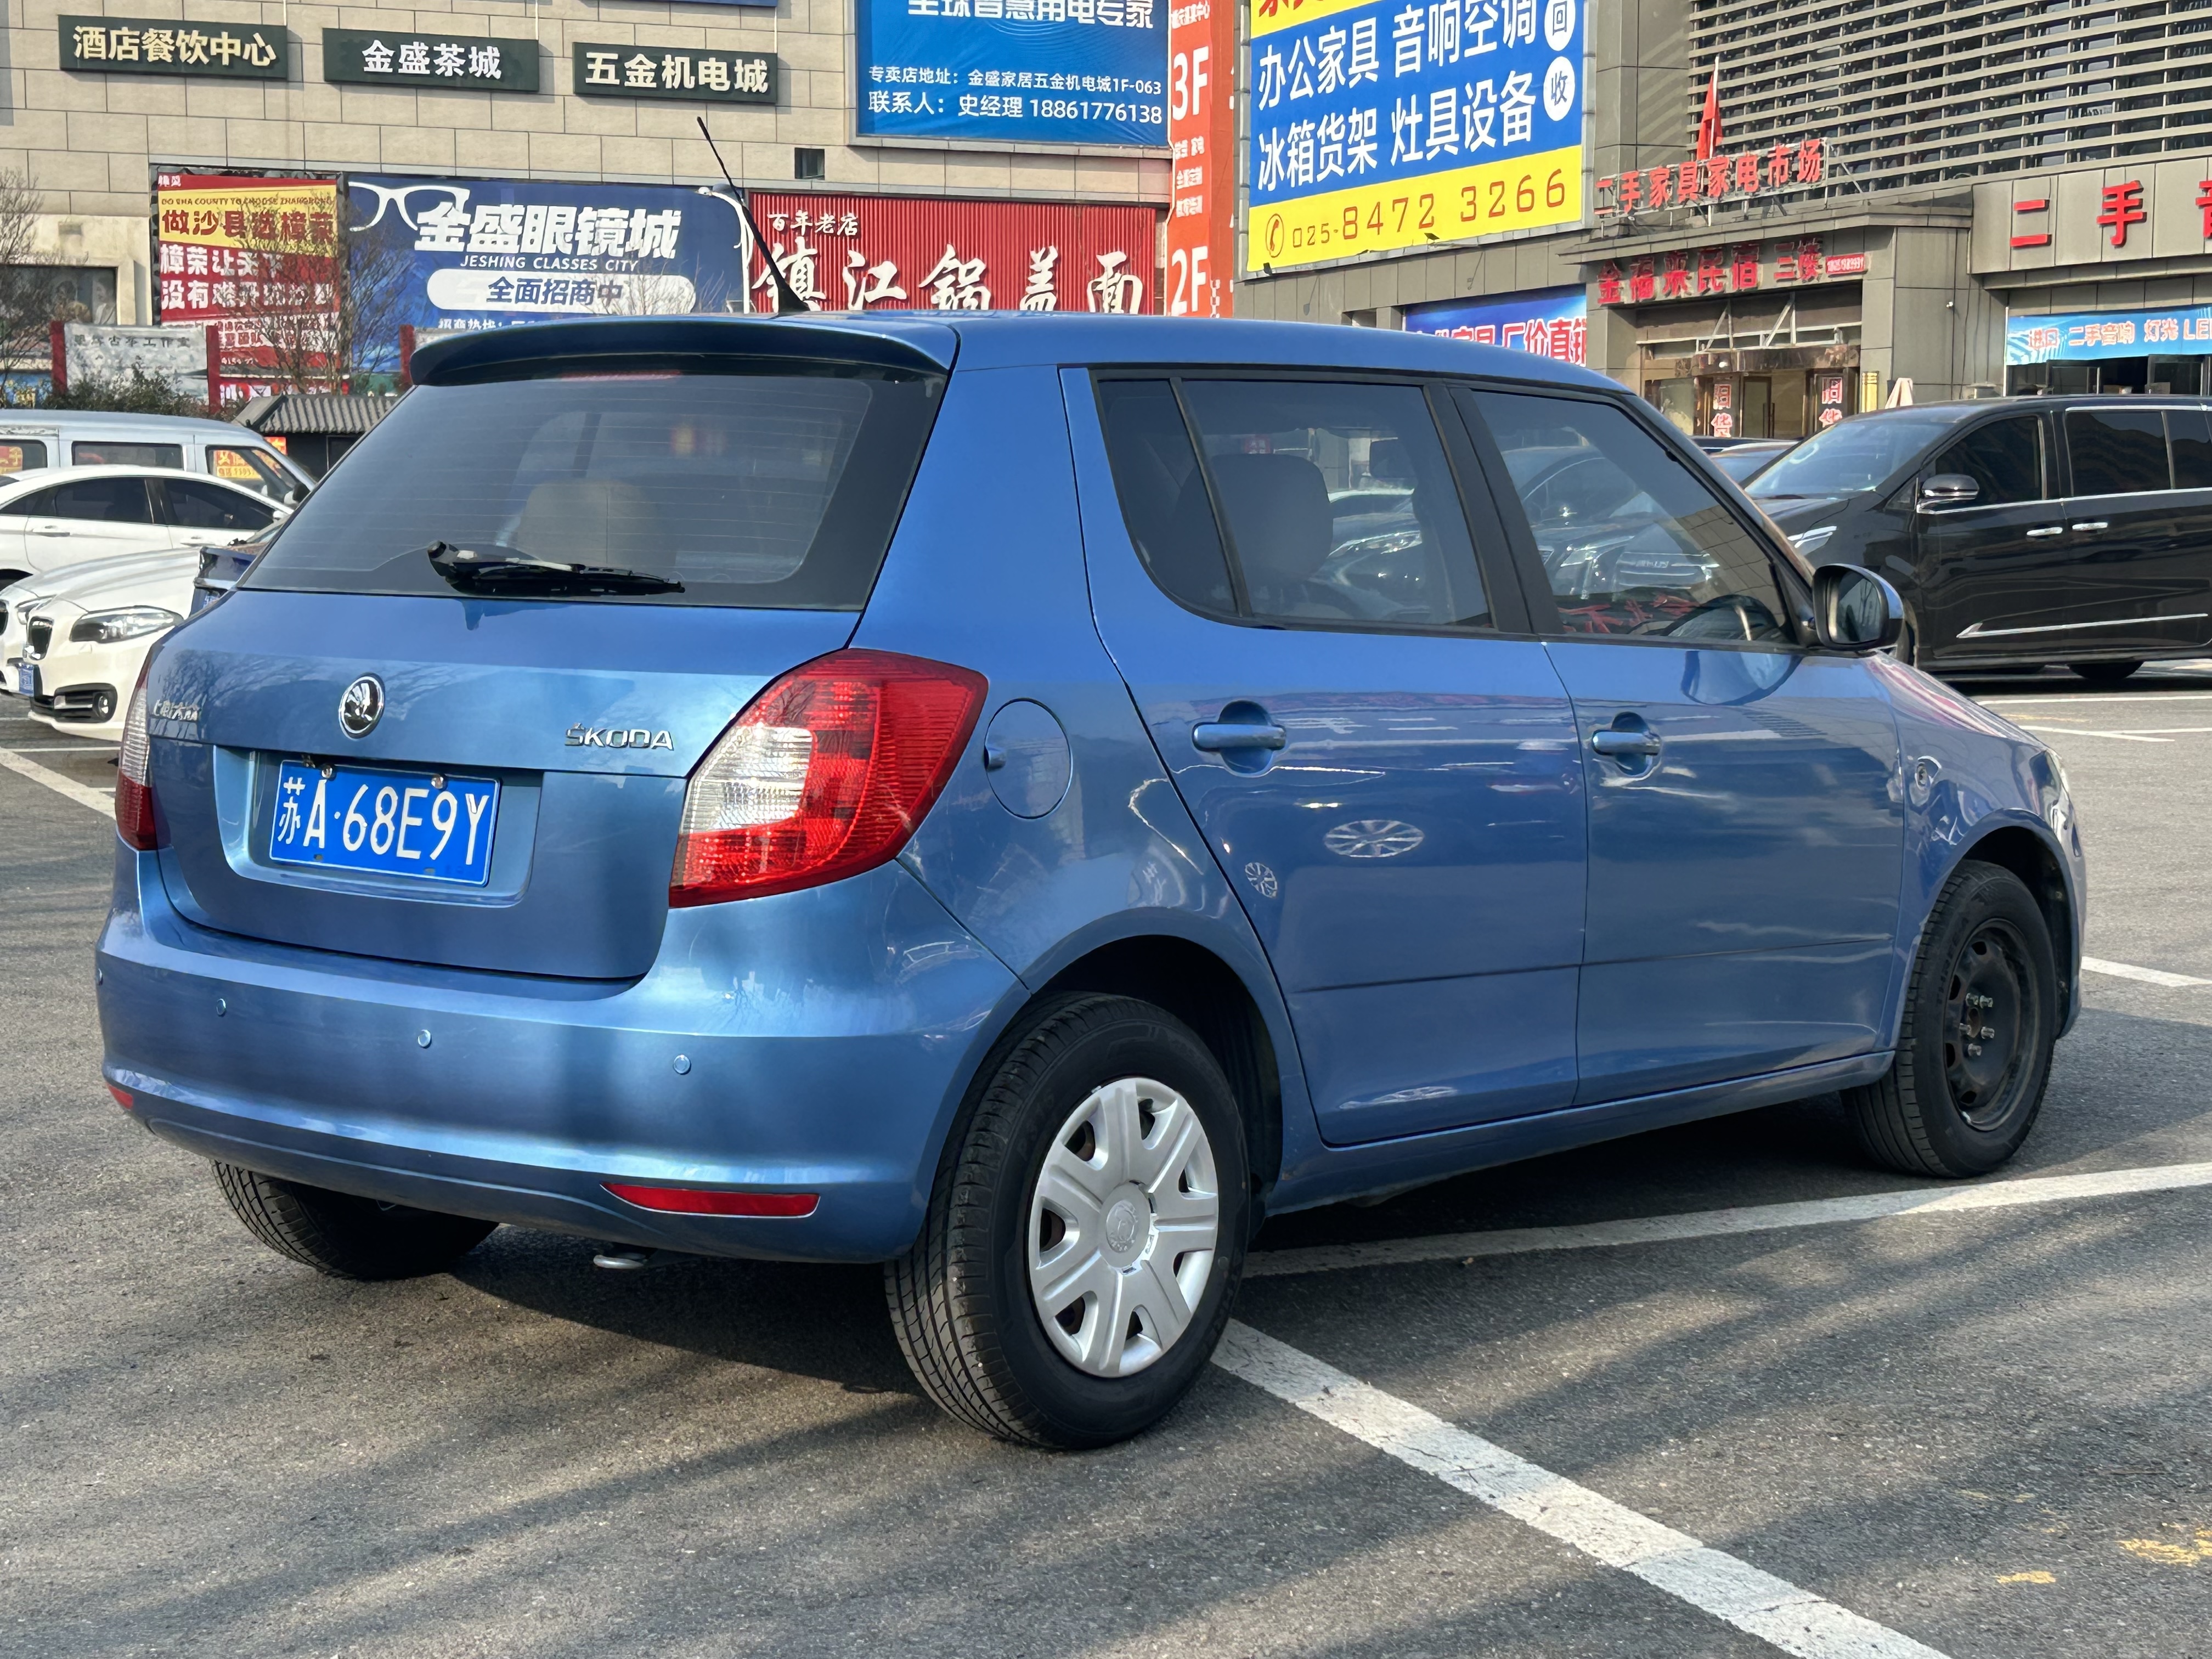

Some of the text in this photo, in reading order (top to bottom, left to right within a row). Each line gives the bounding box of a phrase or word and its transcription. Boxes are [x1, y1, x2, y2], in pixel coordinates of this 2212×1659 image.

[74, 25, 276, 66] 酒店餐饮中心
[362, 39, 502, 80] 金盛茶城
[585, 52, 768, 93] 五金机电城
[1259, 0, 1537, 111] 办公家具 音响空调
[1551, 1, 1568, 106] 回收
[958, 93, 1023, 118] 史经理
[1030, 99, 1163, 125] 18861776138
[1172, 46, 1209, 121] 3F
[1258, 70, 1536, 191] 冰箱货架 灶具设备
[1460, 168, 1565, 223] 3266
[1594, 138, 1822, 215] 二手家具家电市场
[414, 202, 681, 259] 金盛眼镜城
[767, 210, 858, 236] 百年老店
[461, 255, 638, 272] JESHING CLASSES CITY
[486, 276, 623, 306] 全面招商中
[752, 236, 1143, 314] 镇江锅盖面
[1171, 246, 1208, 316] 2F
[1598, 244, 1759, 305] 金福来民宿
[2069, 320, 2135, 347] 二手音响
[2144, 318, 2179, 342] 灯光
[2183, 318, 2212, 340] LE
[565, 722, 674, 751] ŠKODA
